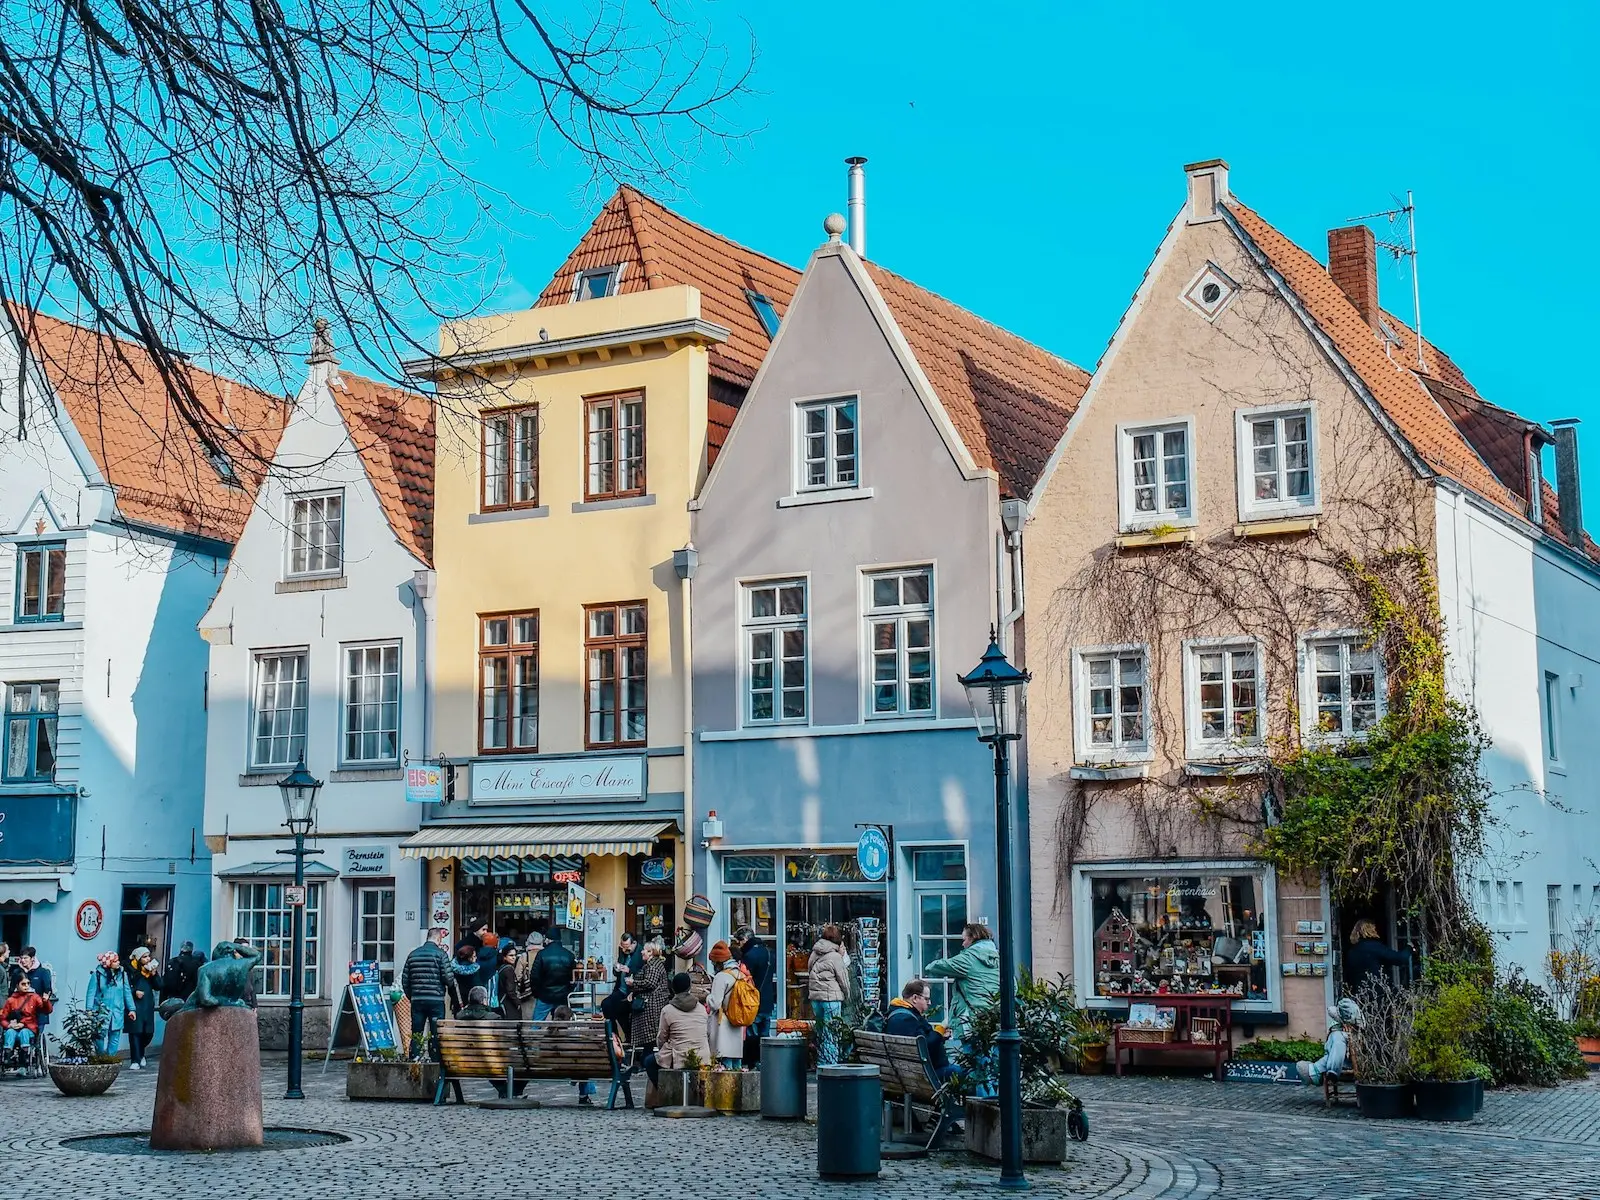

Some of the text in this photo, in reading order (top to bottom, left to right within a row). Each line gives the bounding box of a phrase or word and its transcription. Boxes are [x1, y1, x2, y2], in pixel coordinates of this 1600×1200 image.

[407, 769, 428, 787] EIS
[479, 765, 635, 795] Mini Eiscafé Mario
[346, 849, 385, 860] Bernstein
[348, 861, 383, 873] Zimmer
[802, 858, 829, 881] Die
[552, 871, 582, 883] OPEN
[567, 919, 582, 930] EIS
